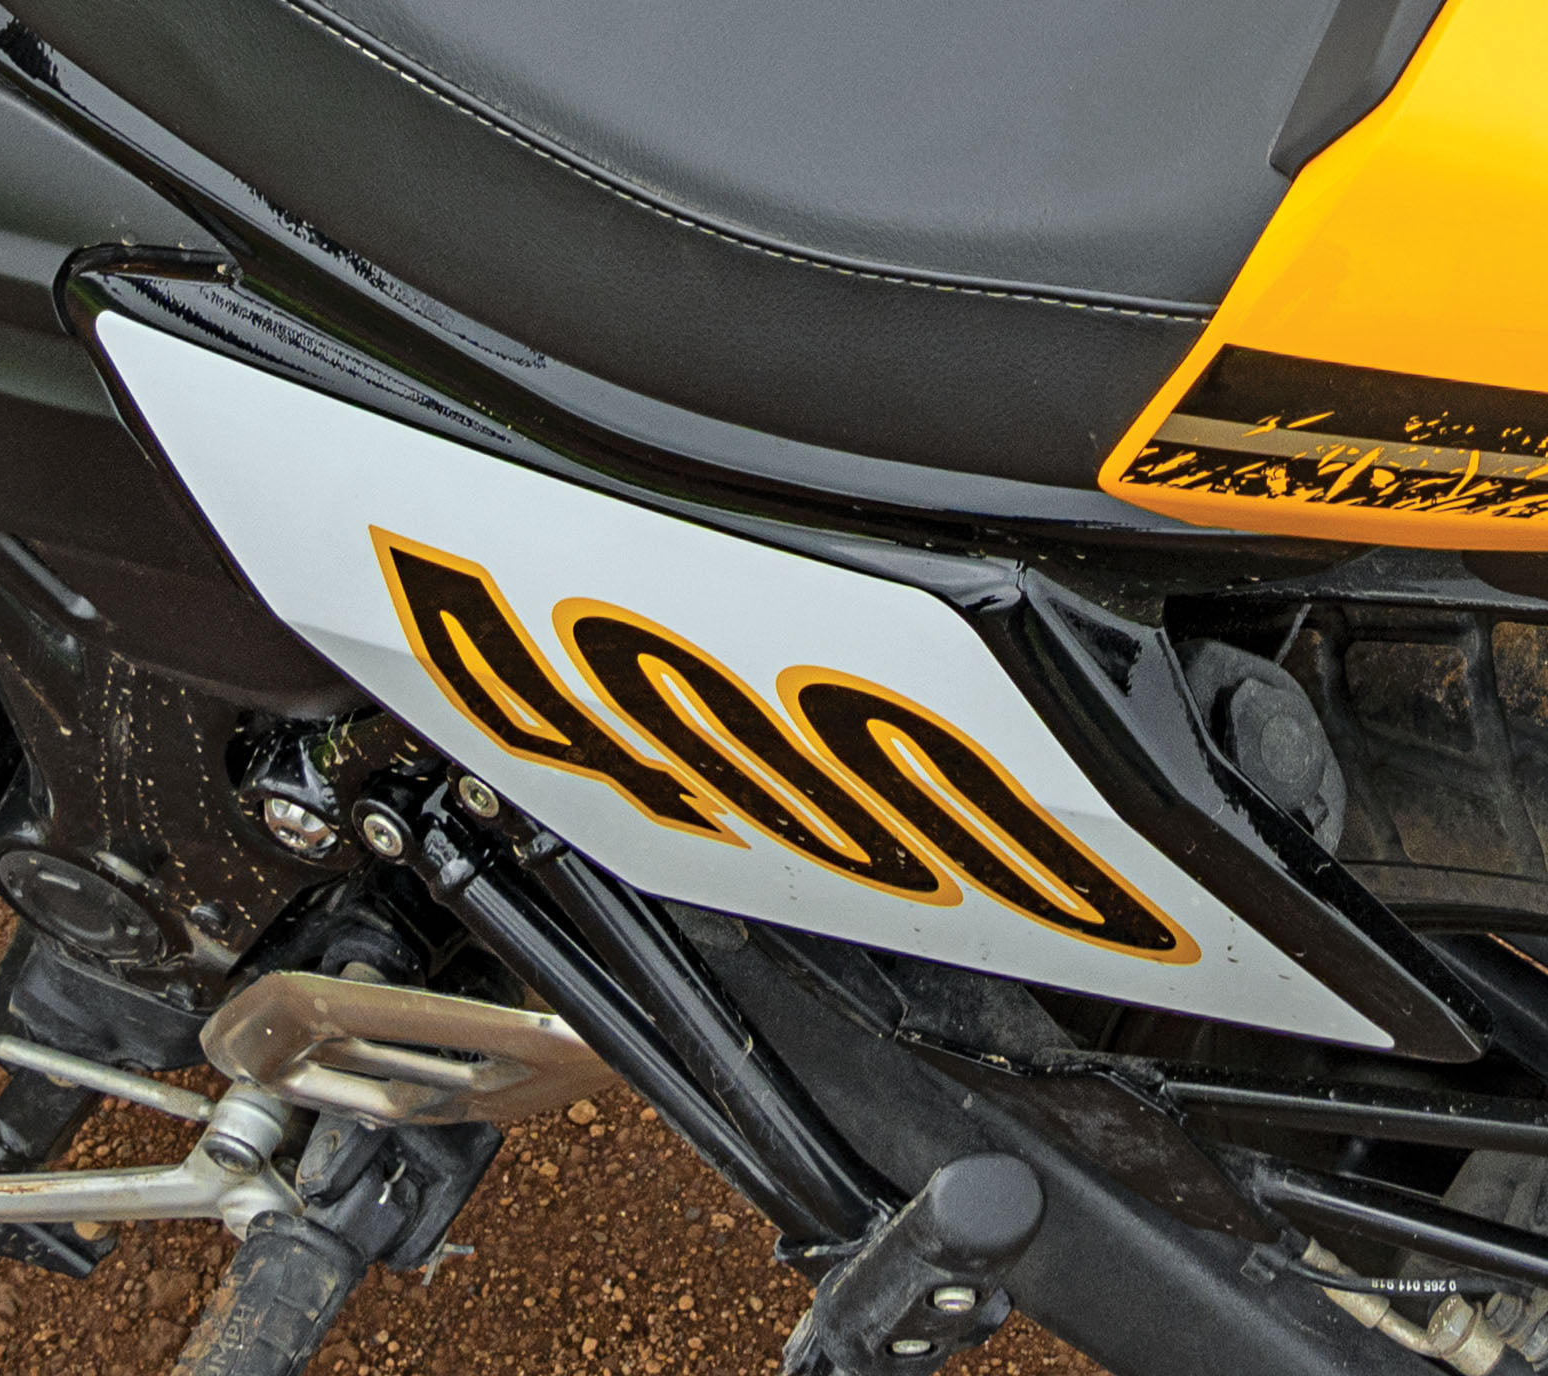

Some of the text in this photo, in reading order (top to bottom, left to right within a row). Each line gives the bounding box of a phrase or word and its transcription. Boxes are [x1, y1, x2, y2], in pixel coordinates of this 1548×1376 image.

[368, 524, 1202, 966] 400
[1398, 1279, 1421, 1292] 011
[1424, 1279, 1447, 1293] 265
